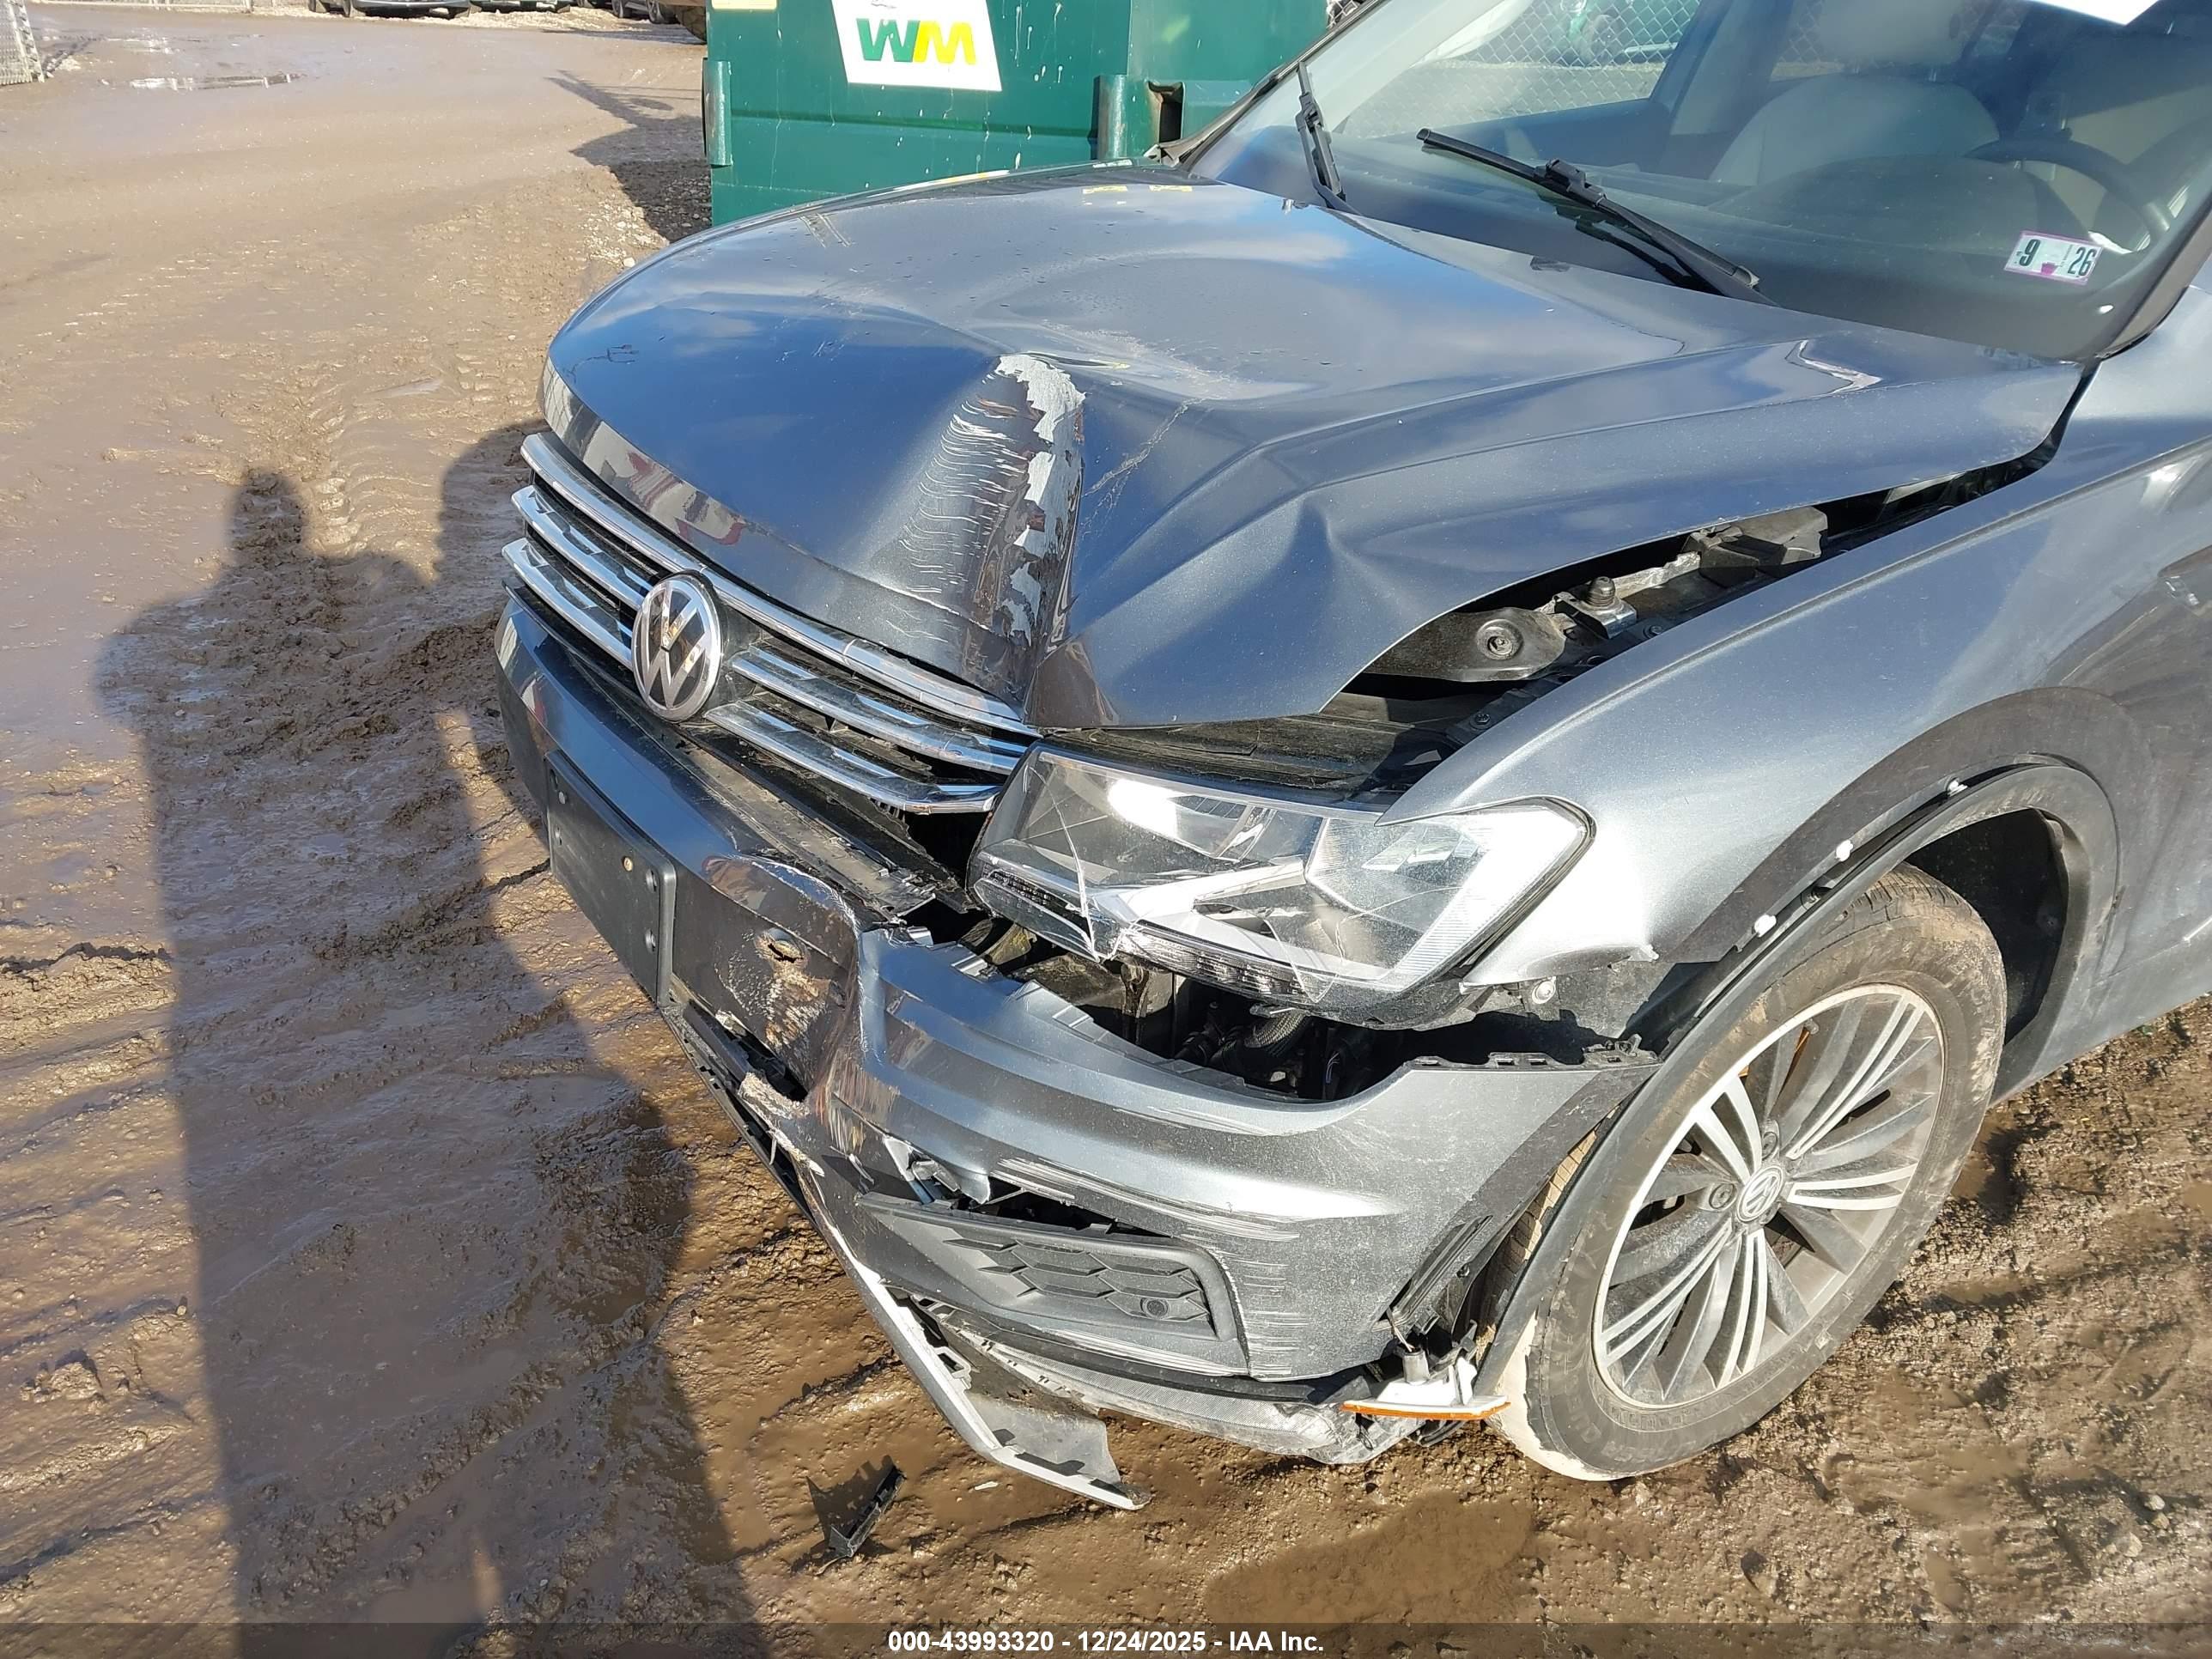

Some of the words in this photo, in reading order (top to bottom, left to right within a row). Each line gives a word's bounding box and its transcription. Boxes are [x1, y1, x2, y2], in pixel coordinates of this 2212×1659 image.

[856, 18, 977, 65] WM
[2019, 239, 2041, 266] 9
[2067, 246, 2098, 276] 26
